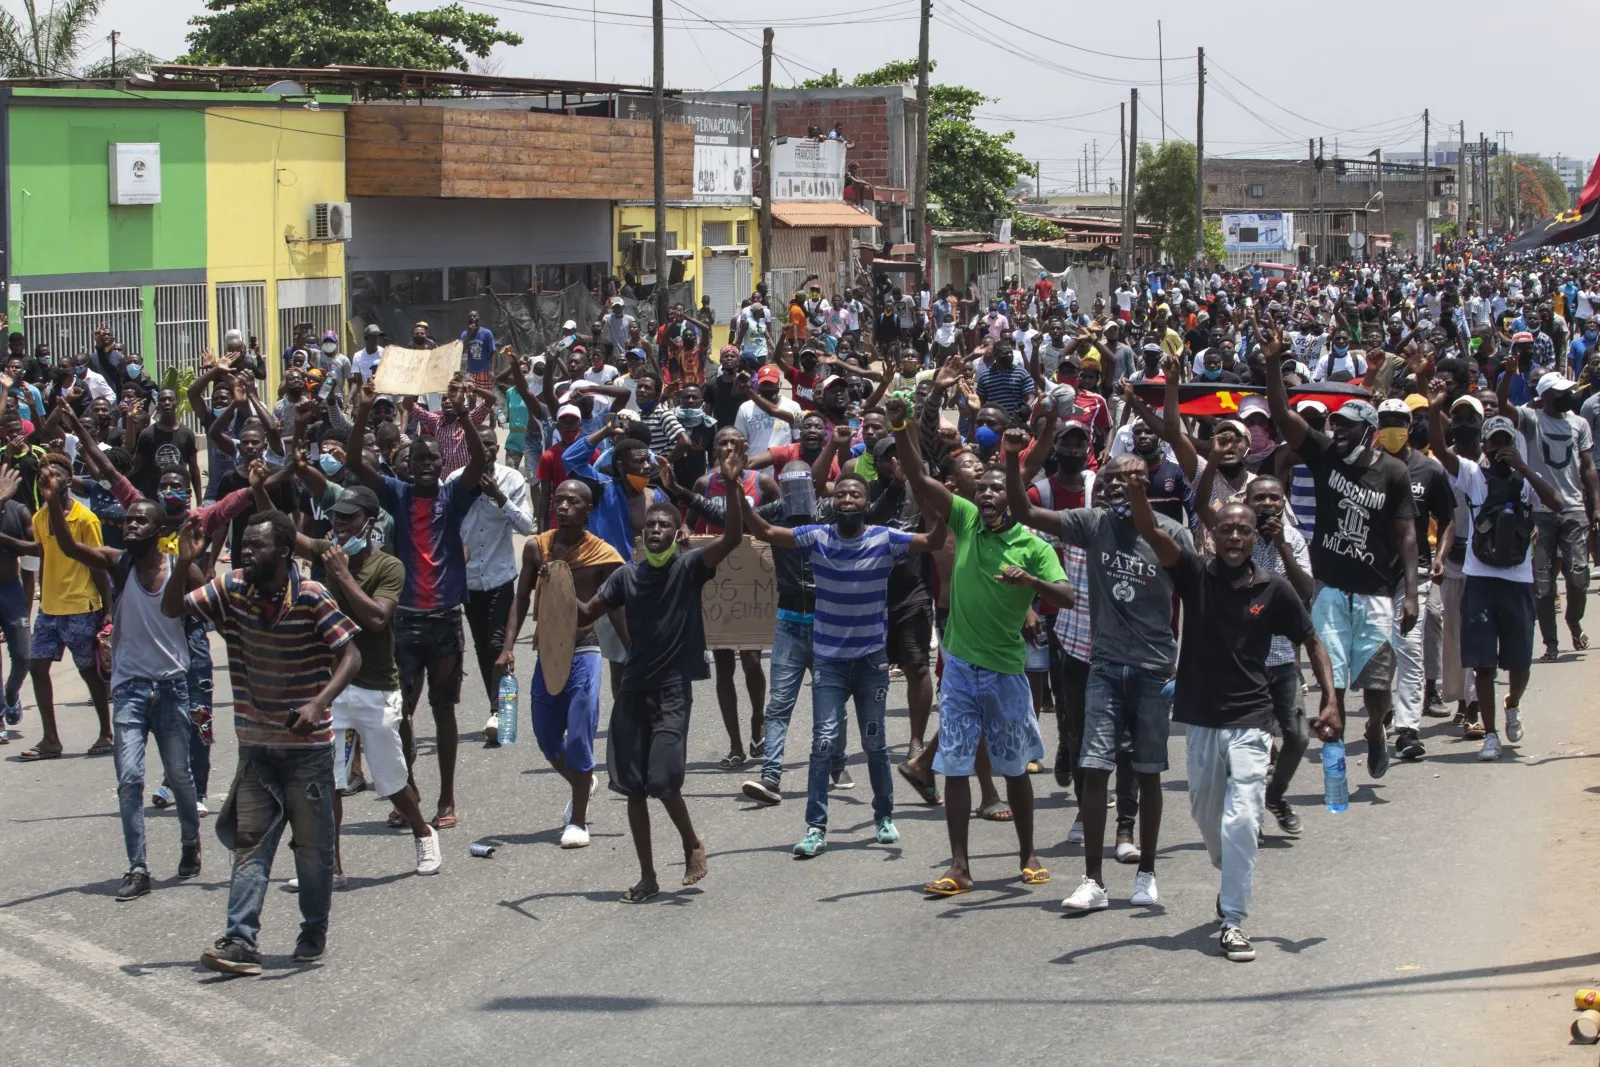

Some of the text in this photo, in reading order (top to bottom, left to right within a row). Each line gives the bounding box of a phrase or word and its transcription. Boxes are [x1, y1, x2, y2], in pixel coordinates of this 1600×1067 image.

[1328, 469, 1386, 510] MOSCHINO
[1322, 533, 1375, 565] MILANO
[1101, 551, 1157, 577] PARIS
[731, 601, 775, 619] EURO
